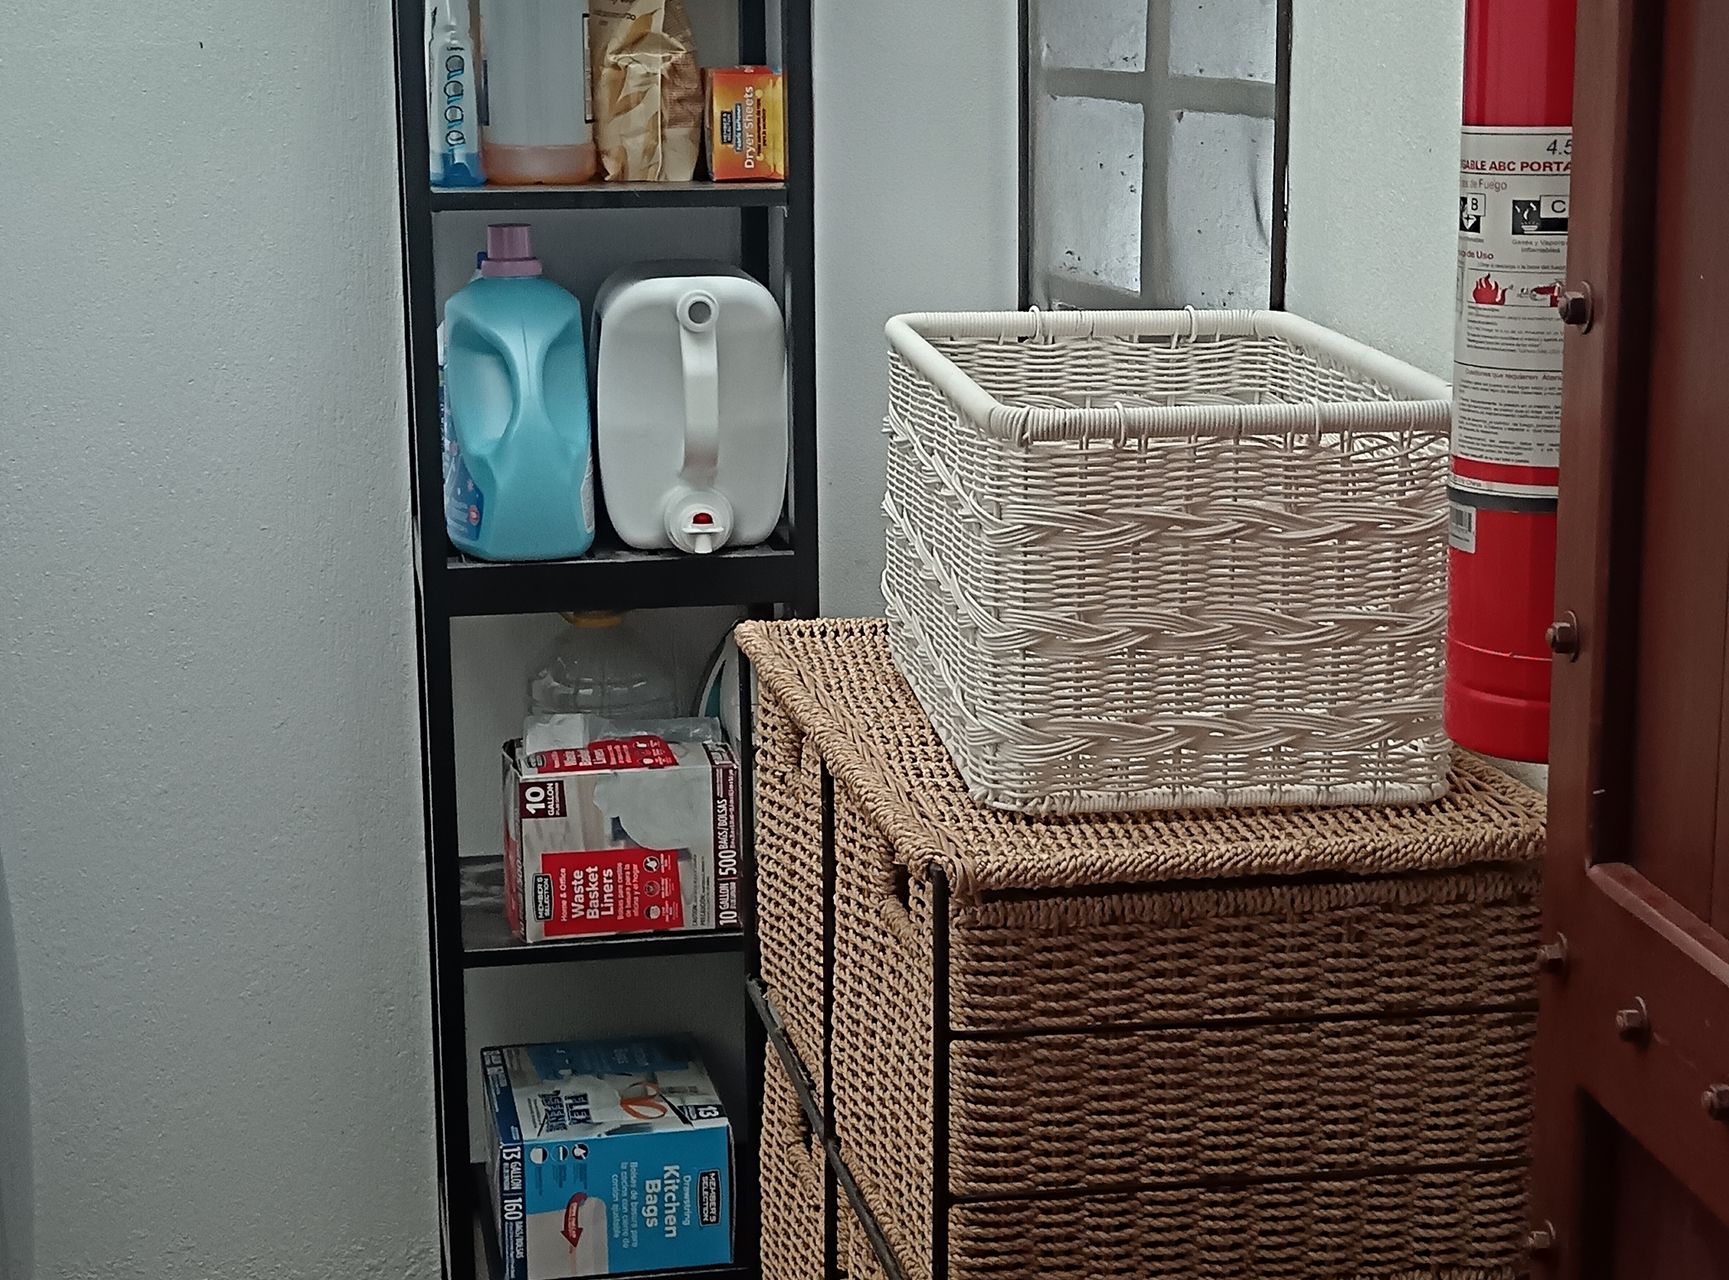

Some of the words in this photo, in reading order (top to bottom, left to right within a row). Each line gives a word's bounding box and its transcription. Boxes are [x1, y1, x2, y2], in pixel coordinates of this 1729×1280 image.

[743, 86, 754, 129] Sheets
[744, 132, 756, 169] Dryer
[1489, 161, 1516, 172] ABC
[1471, 198, 1479, 211] B
[1551, 200, 1566, 214] C
[1476, 251, 1494, 260] Uso
[525, 786, 545, 815] 10
[547, 782, 555, 816] GALLON
[718, 849, 737, 876] 500
[559, 867, 567, 891] Office
[585, 865, 600, 919] Basket
[600, 868, 614, 916] Liners
[571, 869, 585, 919] Waste
[719, 882, 730, 910] GALLON
[719, 911, 738, 926] 10
[502, 1146, 521, 1160] 13
[510, 1161, 522, 1190] GALLON
[503, 1197, 523, 1221] 160
[641, 1179, 661, 1228] Bags
[663, 1165, 680, 1238] Kitchen
[682, 1175, 692, 1226] Drawstring
[702, 1176, 710, 1222] SELECTION
